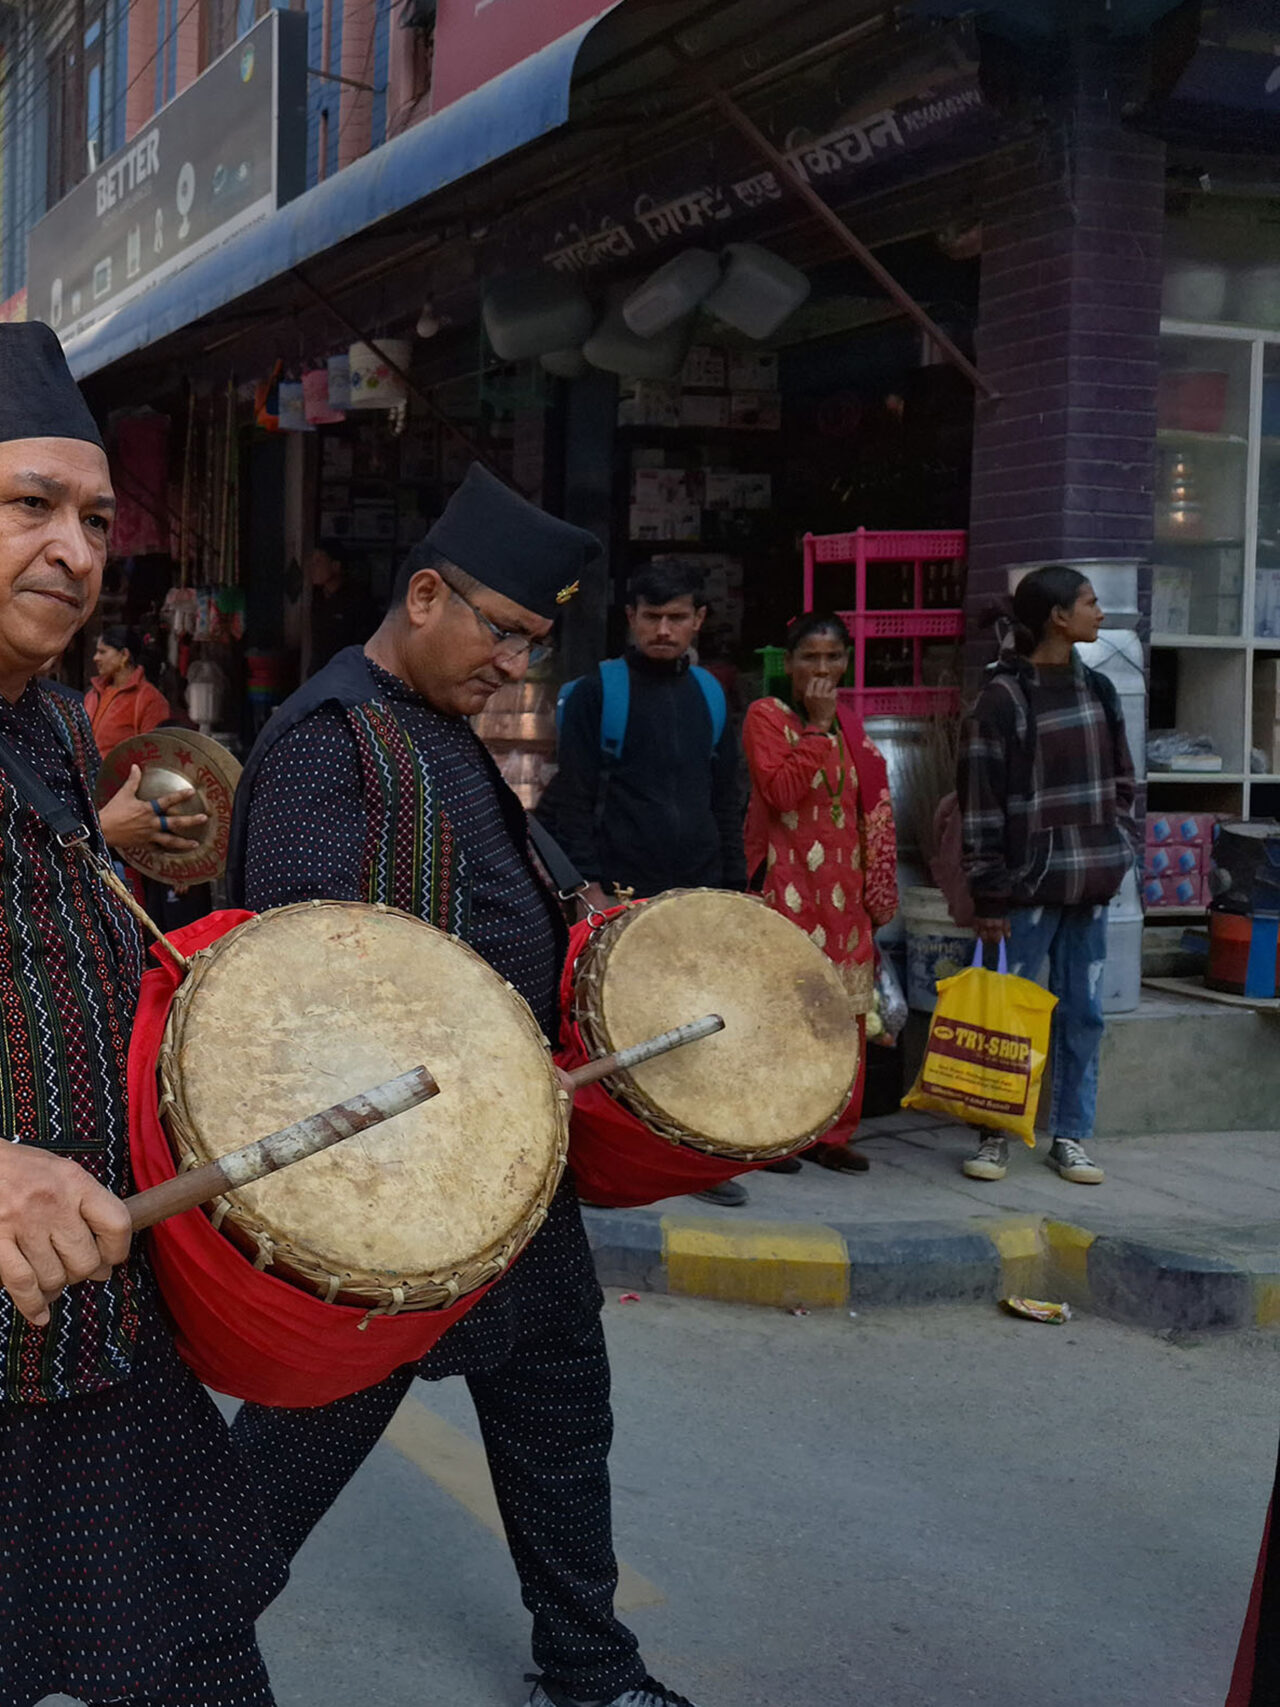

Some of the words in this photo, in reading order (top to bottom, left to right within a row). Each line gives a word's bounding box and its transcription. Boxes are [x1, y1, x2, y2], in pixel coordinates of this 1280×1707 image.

[96, 128, 161, 217] BETTER
[784, 108, 905, 185] किचन
[955, 1027, 1030, 1061] TRY-SHOP
